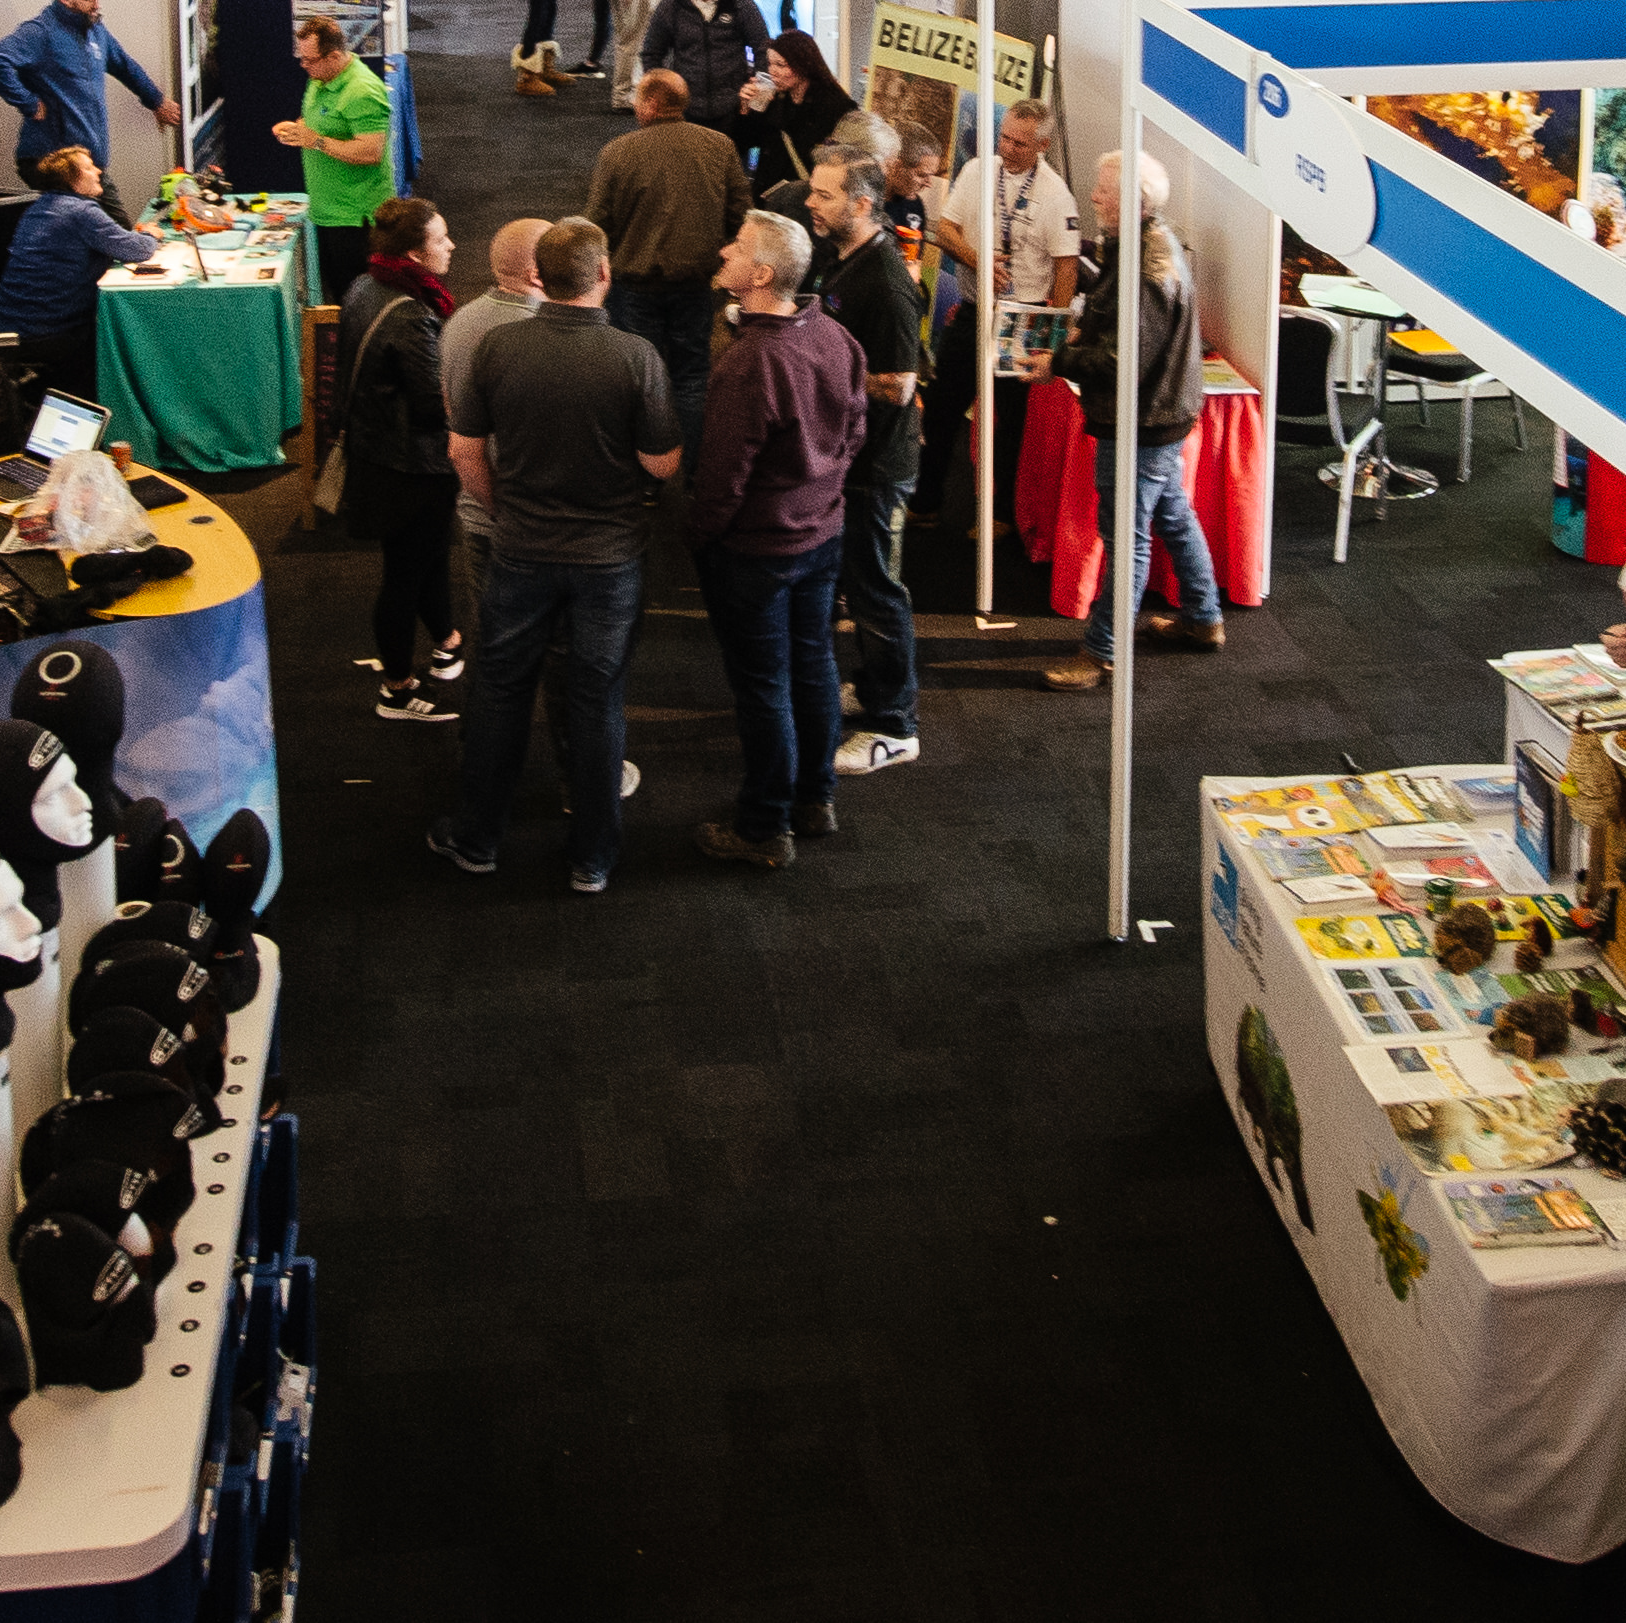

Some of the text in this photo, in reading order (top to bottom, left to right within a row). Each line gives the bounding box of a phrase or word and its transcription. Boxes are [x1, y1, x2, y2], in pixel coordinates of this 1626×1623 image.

[878, 18, 1030, 91] BELIZE BIZE
[1295, 153, 1327, 194] RSPB
